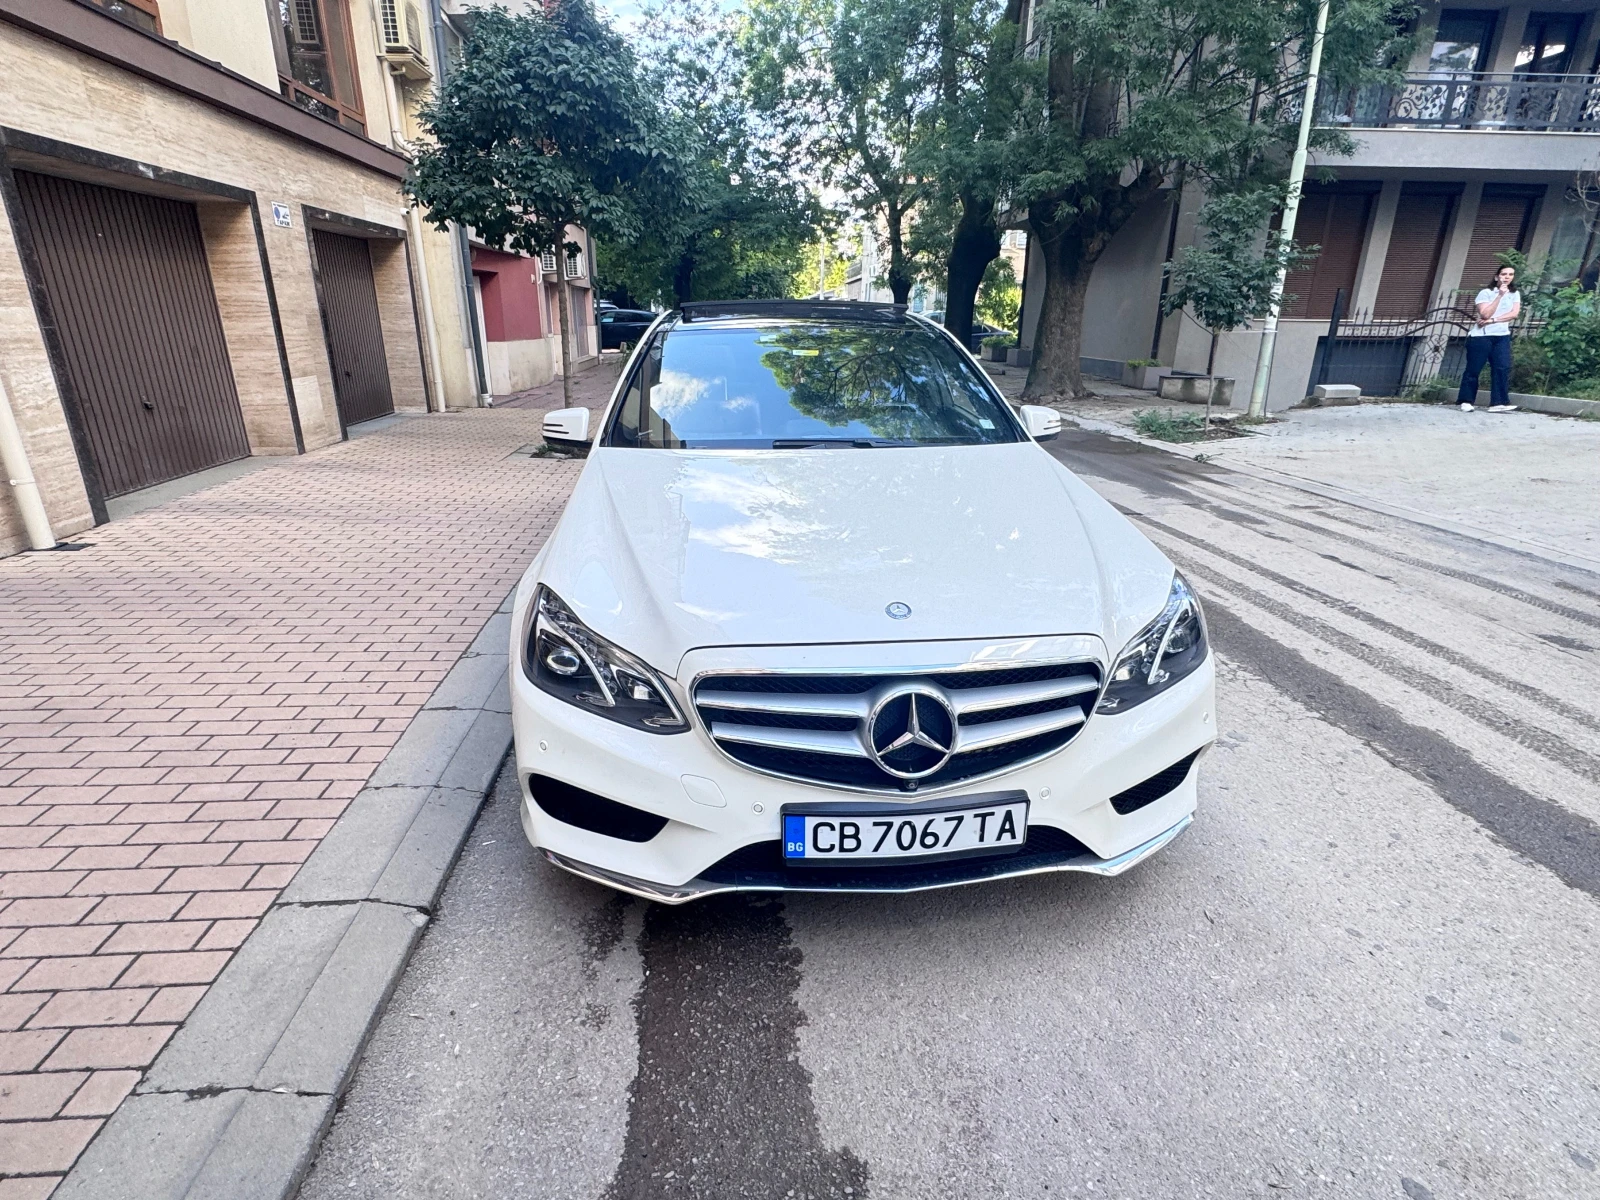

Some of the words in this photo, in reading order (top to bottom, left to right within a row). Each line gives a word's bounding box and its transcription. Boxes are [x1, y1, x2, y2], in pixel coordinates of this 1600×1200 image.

[812, 821, 862, 853] CB
[871, 815, 965, 853] 7067
[973, 809, 1017, 843] TA
[787, 842, 804, 852] BG
